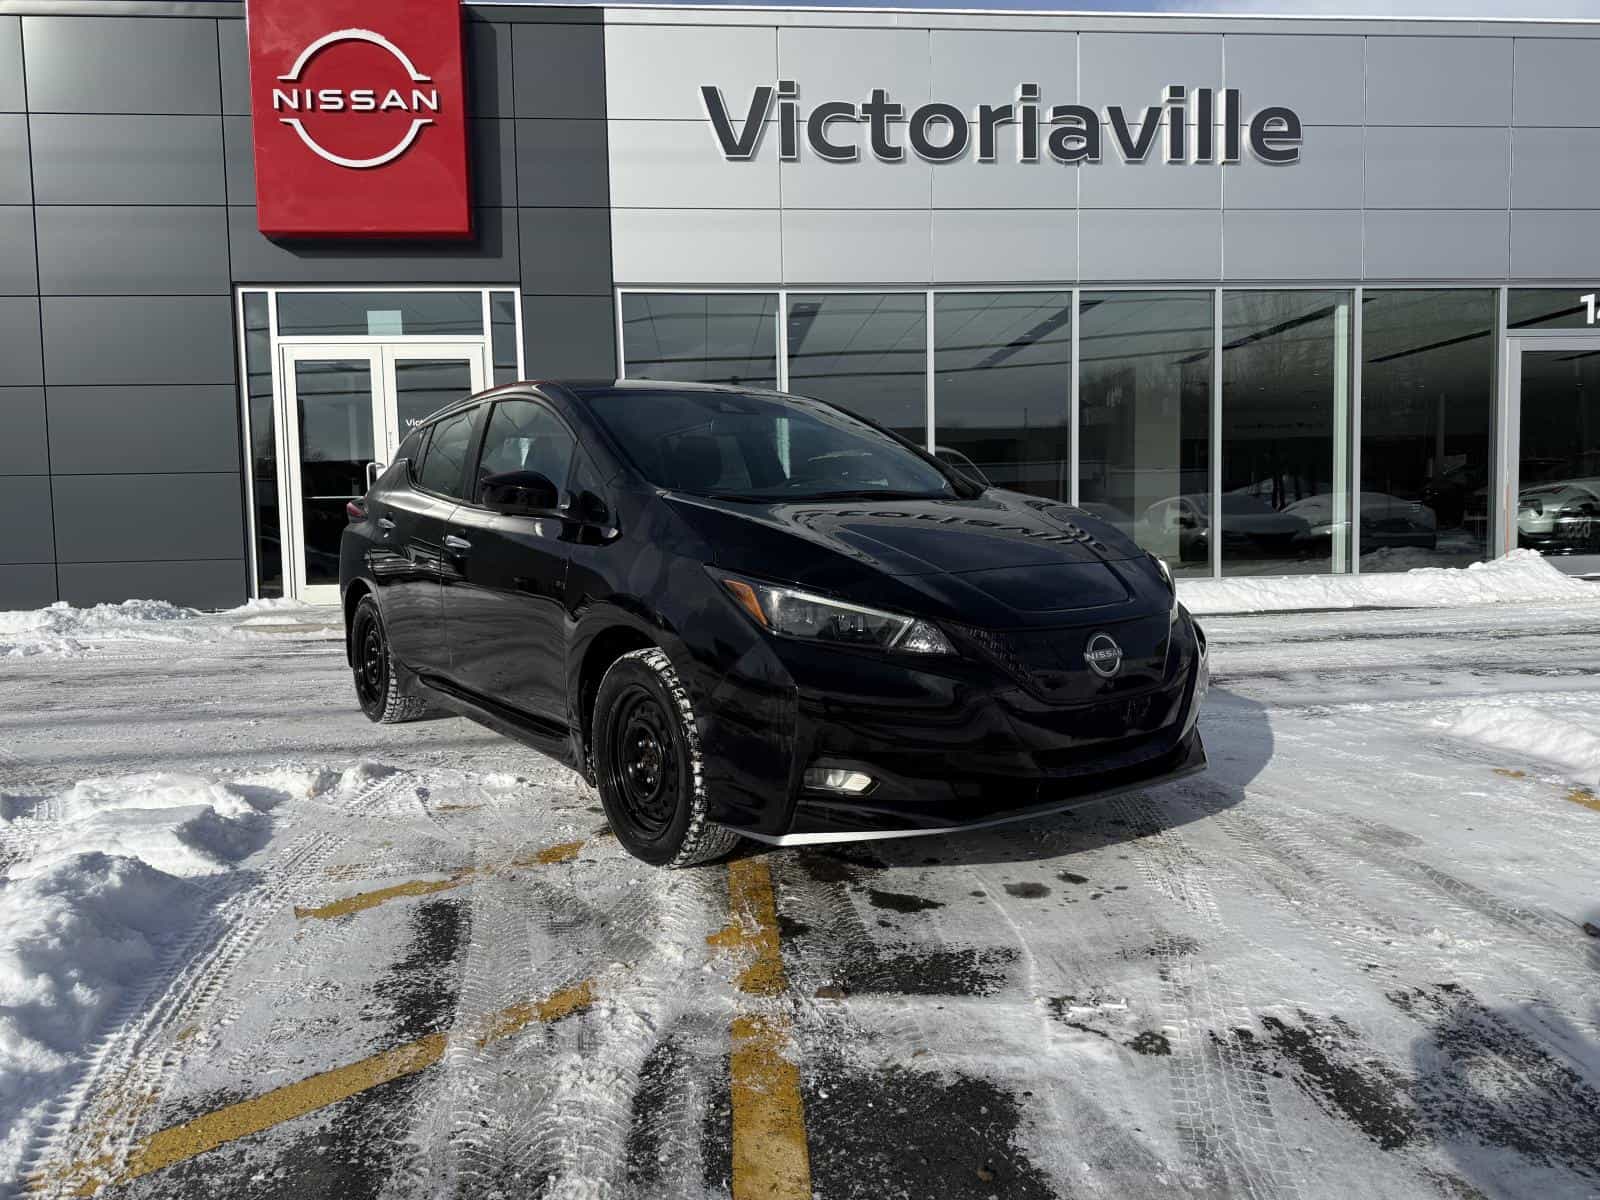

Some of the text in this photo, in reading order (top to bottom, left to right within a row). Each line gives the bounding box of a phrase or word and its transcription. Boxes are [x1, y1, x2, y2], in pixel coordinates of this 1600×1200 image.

[272, 88, 438, 110] NISSAN
[700, 80, 1302, 164] Victoriaville
[1579, 293, 1600, 325] 1
[1083, 648, 1123, 661] NISSAN
